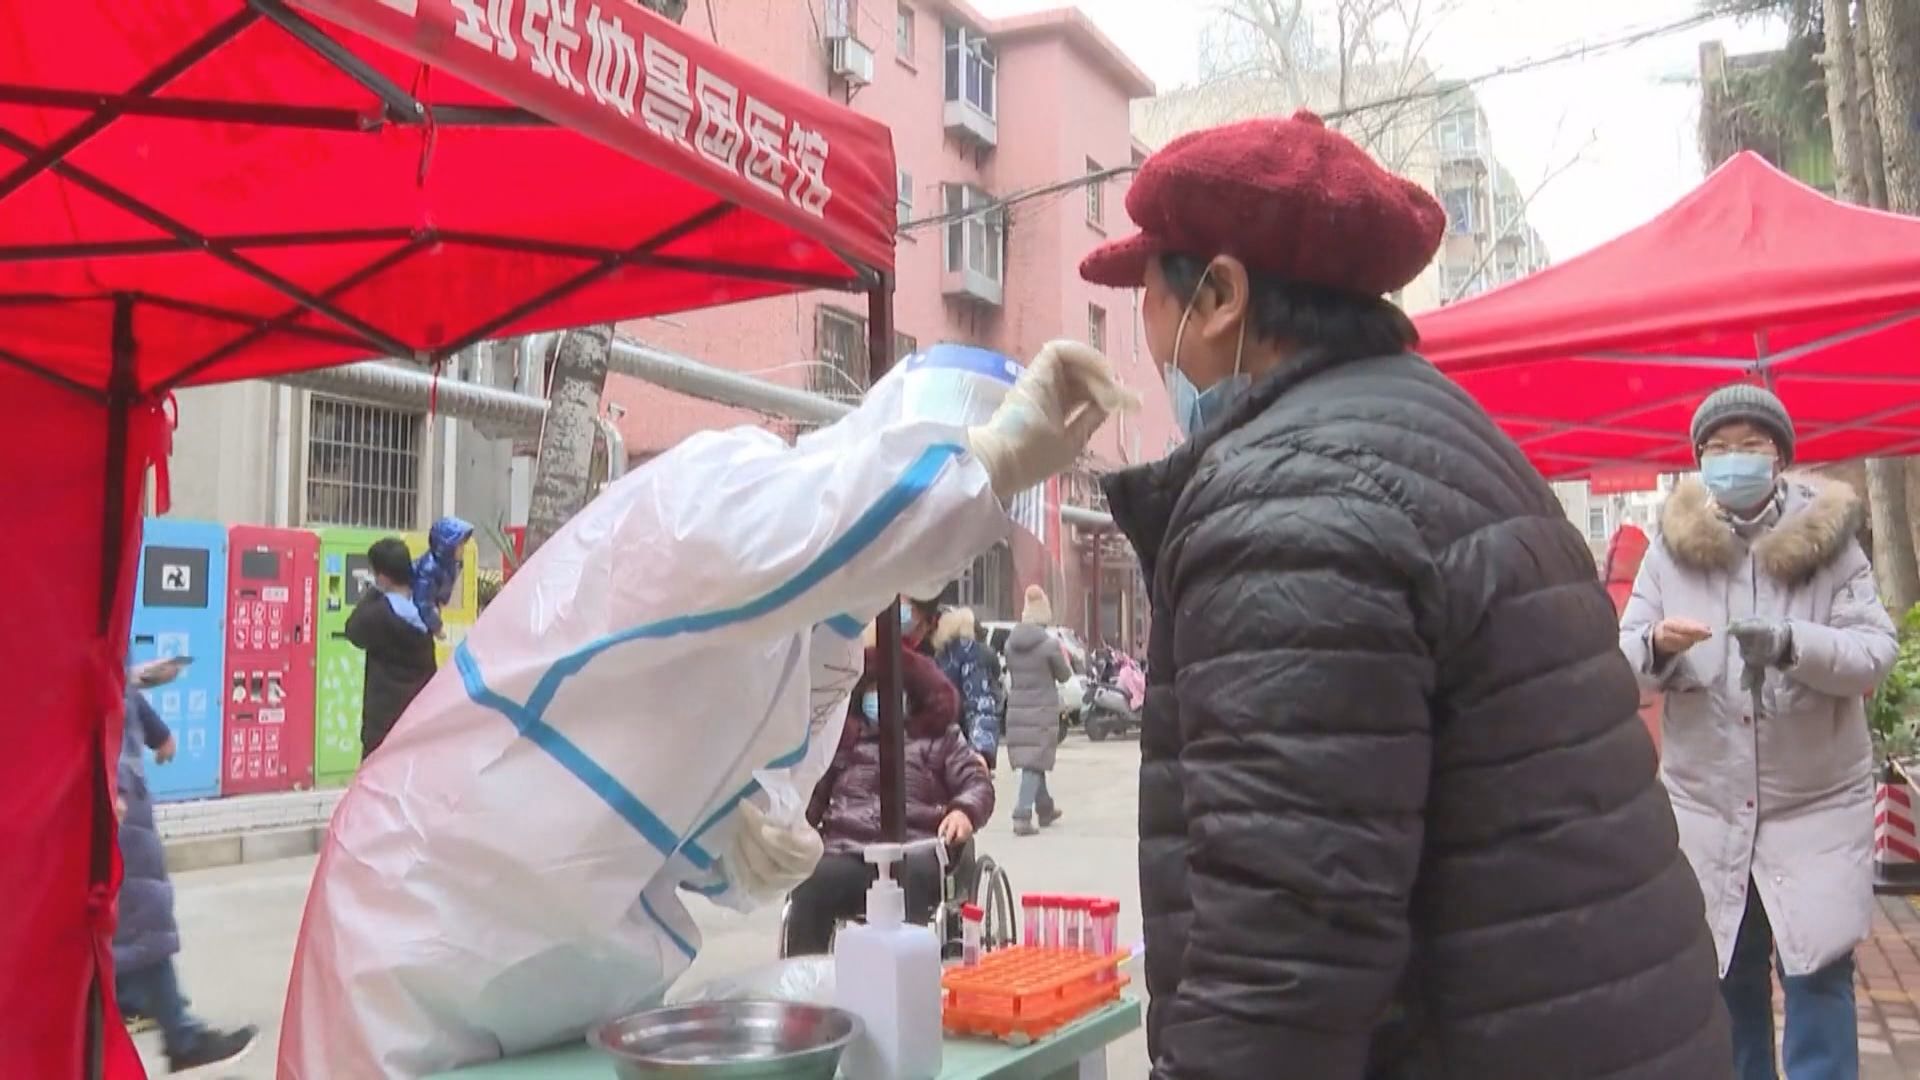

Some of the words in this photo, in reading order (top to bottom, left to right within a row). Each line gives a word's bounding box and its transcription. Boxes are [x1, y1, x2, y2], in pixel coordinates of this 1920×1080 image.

[376, 0, 832, 219] 到张仲景国医馆
